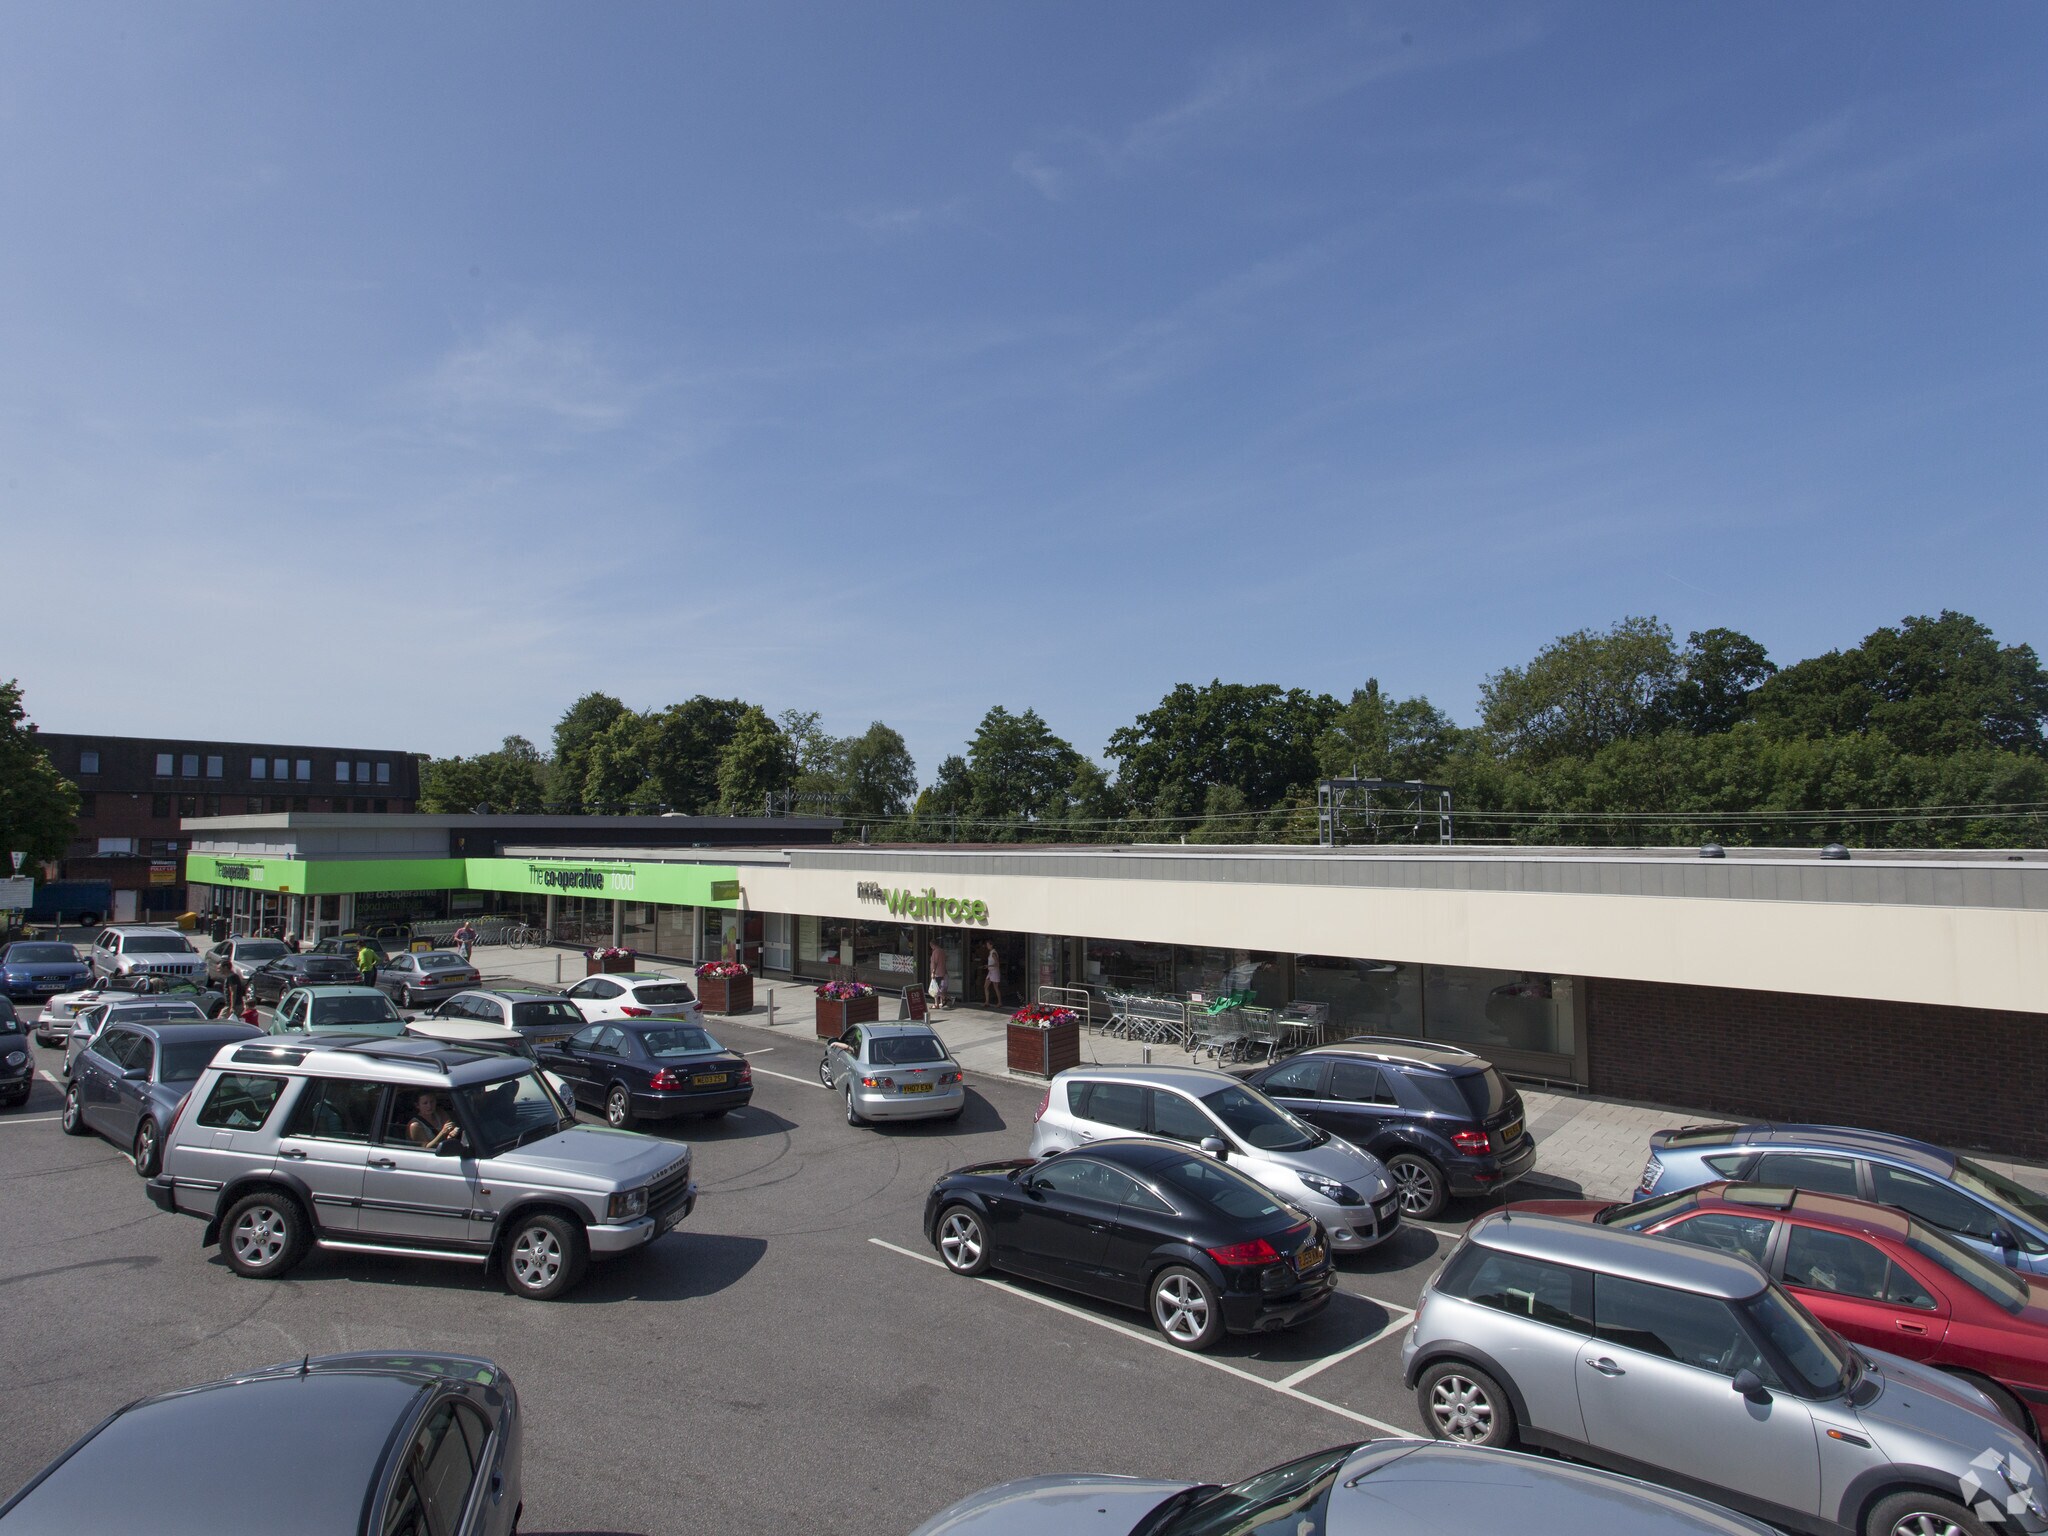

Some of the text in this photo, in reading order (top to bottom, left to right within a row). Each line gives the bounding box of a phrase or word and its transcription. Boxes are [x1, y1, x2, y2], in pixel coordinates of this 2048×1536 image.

[529, 865, 635, 892] The co-operative food
[882, 887, 987, 921] Waitrose
[652, 1168, 668, 1180] LAND
